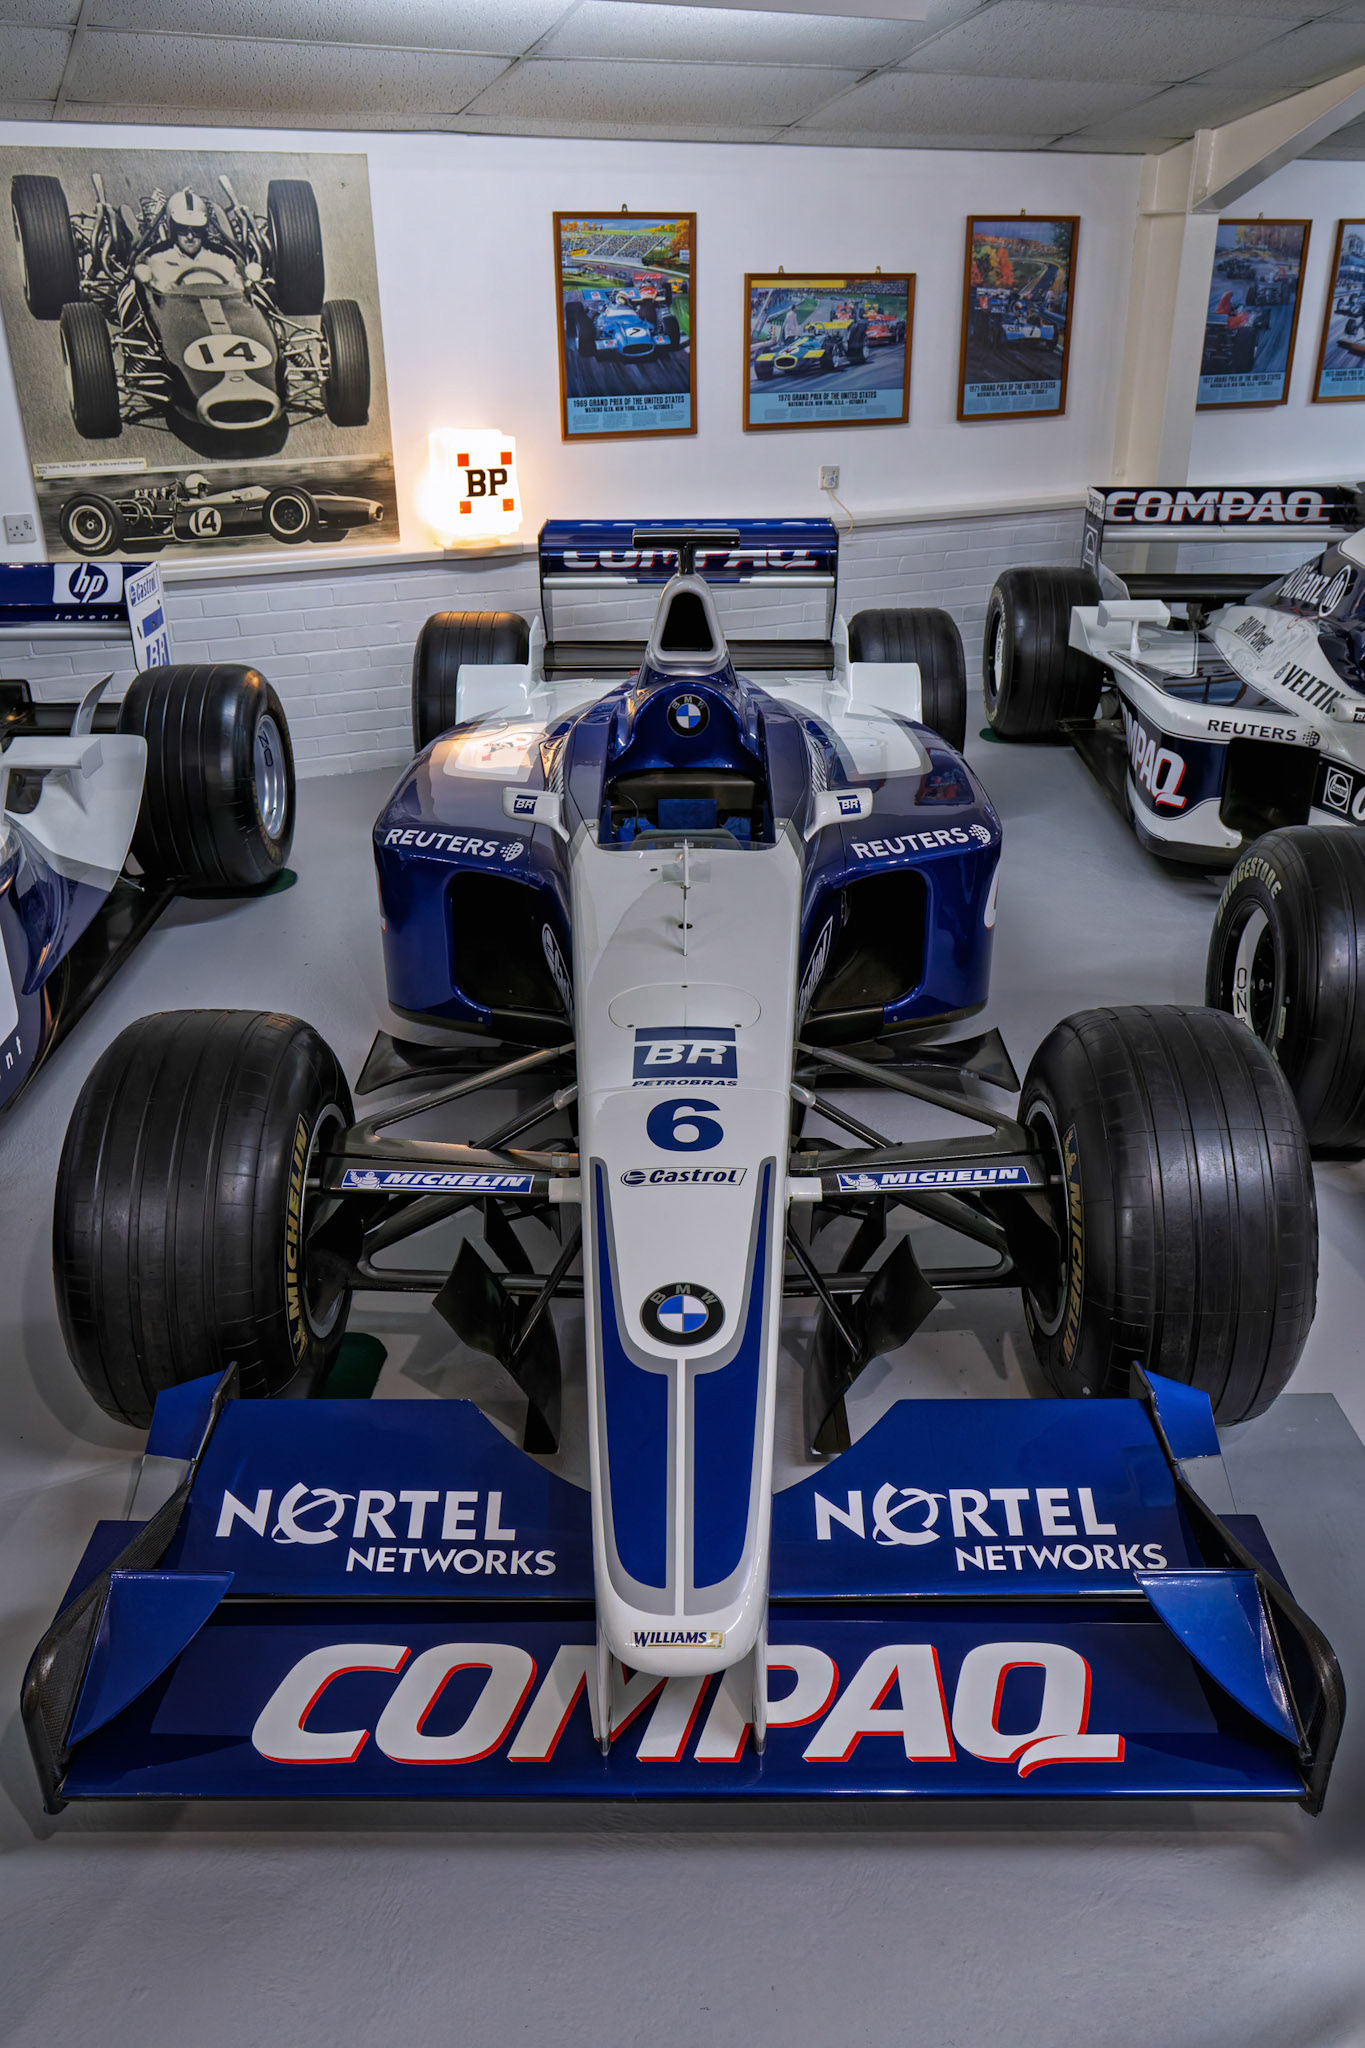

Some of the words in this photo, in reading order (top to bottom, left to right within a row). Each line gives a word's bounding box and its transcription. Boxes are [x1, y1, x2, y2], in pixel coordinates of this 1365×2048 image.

[198, 342, 256, 364] 14
[573, 400, 588, 408] 1969
[589, 398, 608, 406] GRAND
[610, 398, 622, 406] PRIX
[624, 397, 632, 405] OF
[633, 397, 643, 405] THE
[644, 396, 663, 404] UNITED
[665, 395, 684, 404] STATES
[778, 394, 791, 402] 1970
[792, 393, 809, 401] GRAND
[823, 392, 830, 400] OF
[831, 392, 840, 400] THE
[859, 391, 877, 399] STATES
[464, 468, 508, 497] BP
[1105, 491, 1330, 523] COMPAQ
[194, 510, 217, 532] 14
[73, 563, 104, 603] hp
[136, 573, 157, 601] Castrol
[1275, 565, 1331, 605] Allianz
[672, 696, 706, 710] BMW
[1208, 720, 1297, 742] REUTERS
[516, 798, 535, 810] BR
[842, 799, 859, 810] BR
[384, 828, 500, 858] REUTERS
[850, 827, 970, 860] REUTERS
[643, 1044, 728, 1065] BR
[632, 1079, 738, 1087] PETROBRAS
[646, 1098, 724, 1152] 6
[386, 1172, 526, 1187] MICHELIN
[650, 1168, 736, 1183] Castrol
[881, 1168, 1020, 1184] MICHELIN
[287, 1120, 308, 1321] MICHELIN
[1063, 1182, 1083, 1363] MICHELIN
[650, 1284, 718, 1304] BMW
[216, 1482, 516, 1544] NORTEL
[814, 1482, 1118, 1546] NORTEL
[346, 1546, 556, 1576] NETWORKS
[954, 1543, 1168, 1572] NETWORKS
[634, 1632, 707, 1647] WILLIAMS
[251, 1642, 1125, 1778] COMPAQ
